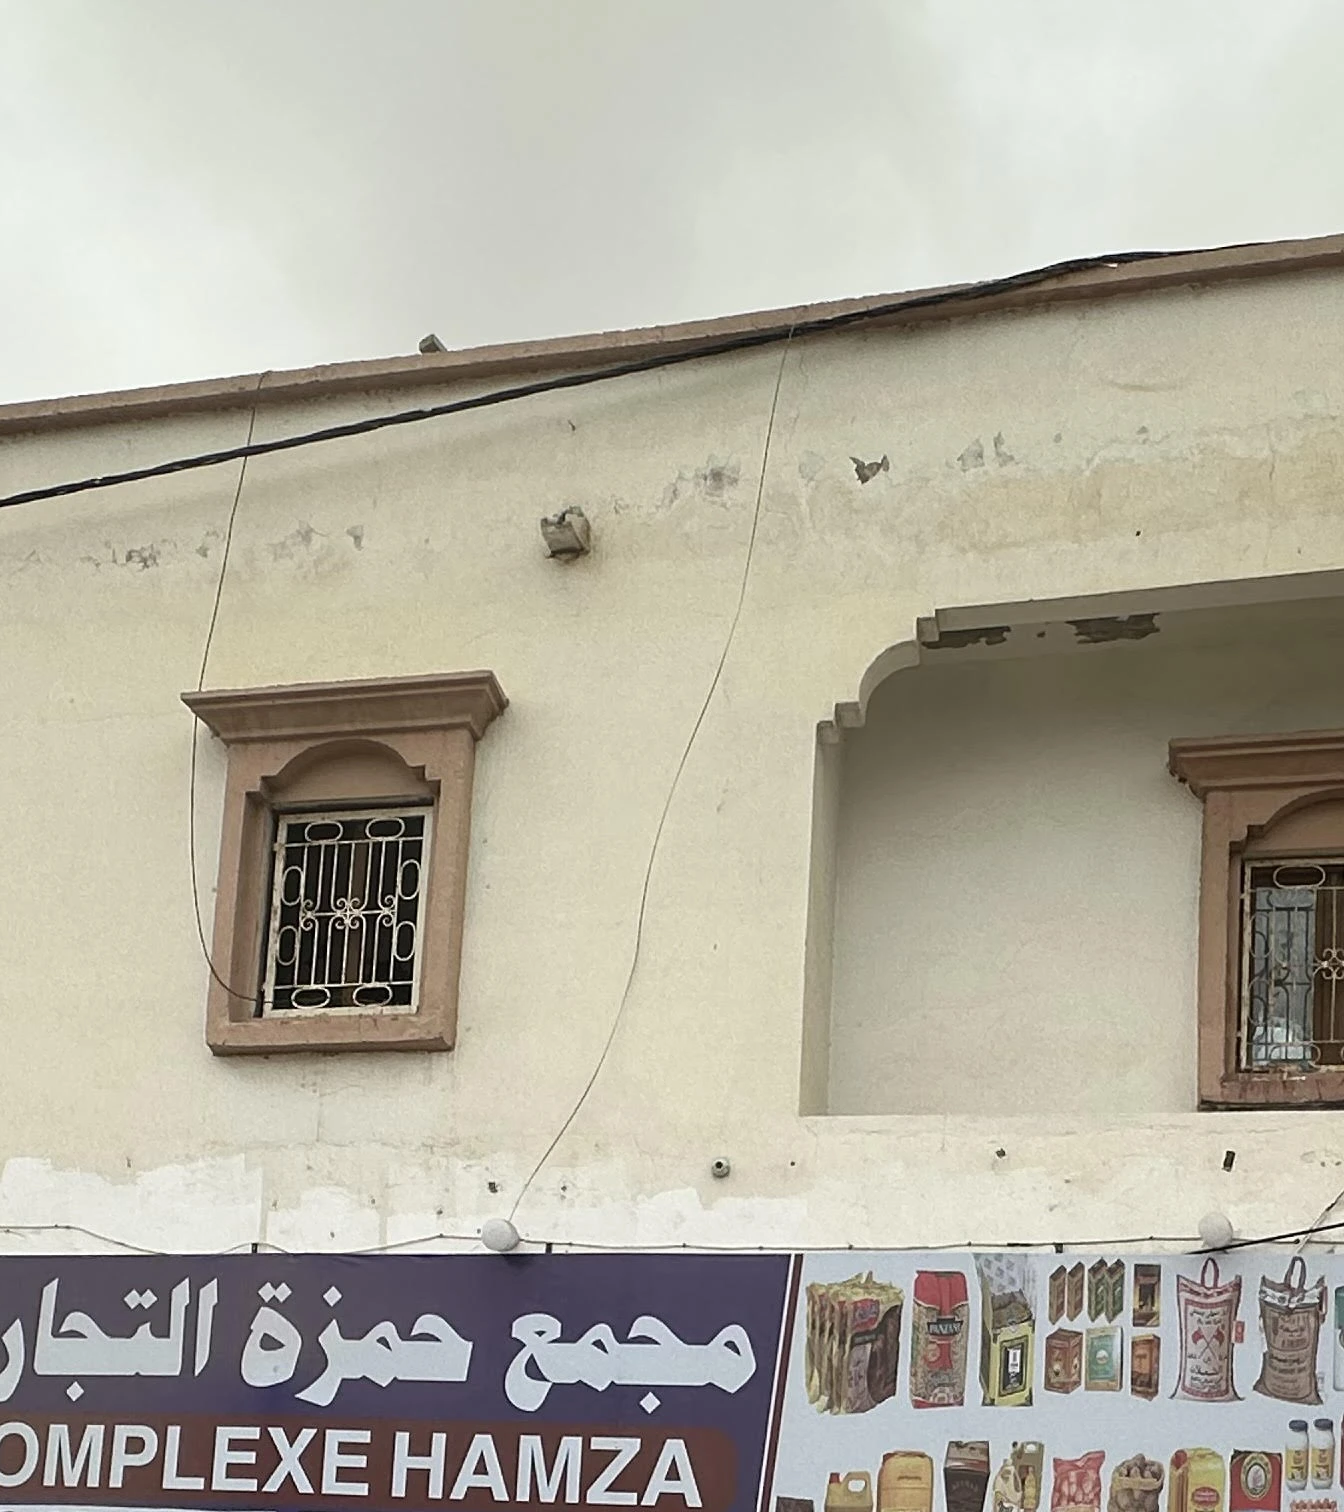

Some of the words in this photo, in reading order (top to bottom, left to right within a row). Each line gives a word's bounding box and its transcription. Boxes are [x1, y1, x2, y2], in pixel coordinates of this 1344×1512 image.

[240, 1281, 474, 1408] حمزة
[504, 1312, 756, 1415] مجمع
[391, 1431, 703, 1509] HAMZA
